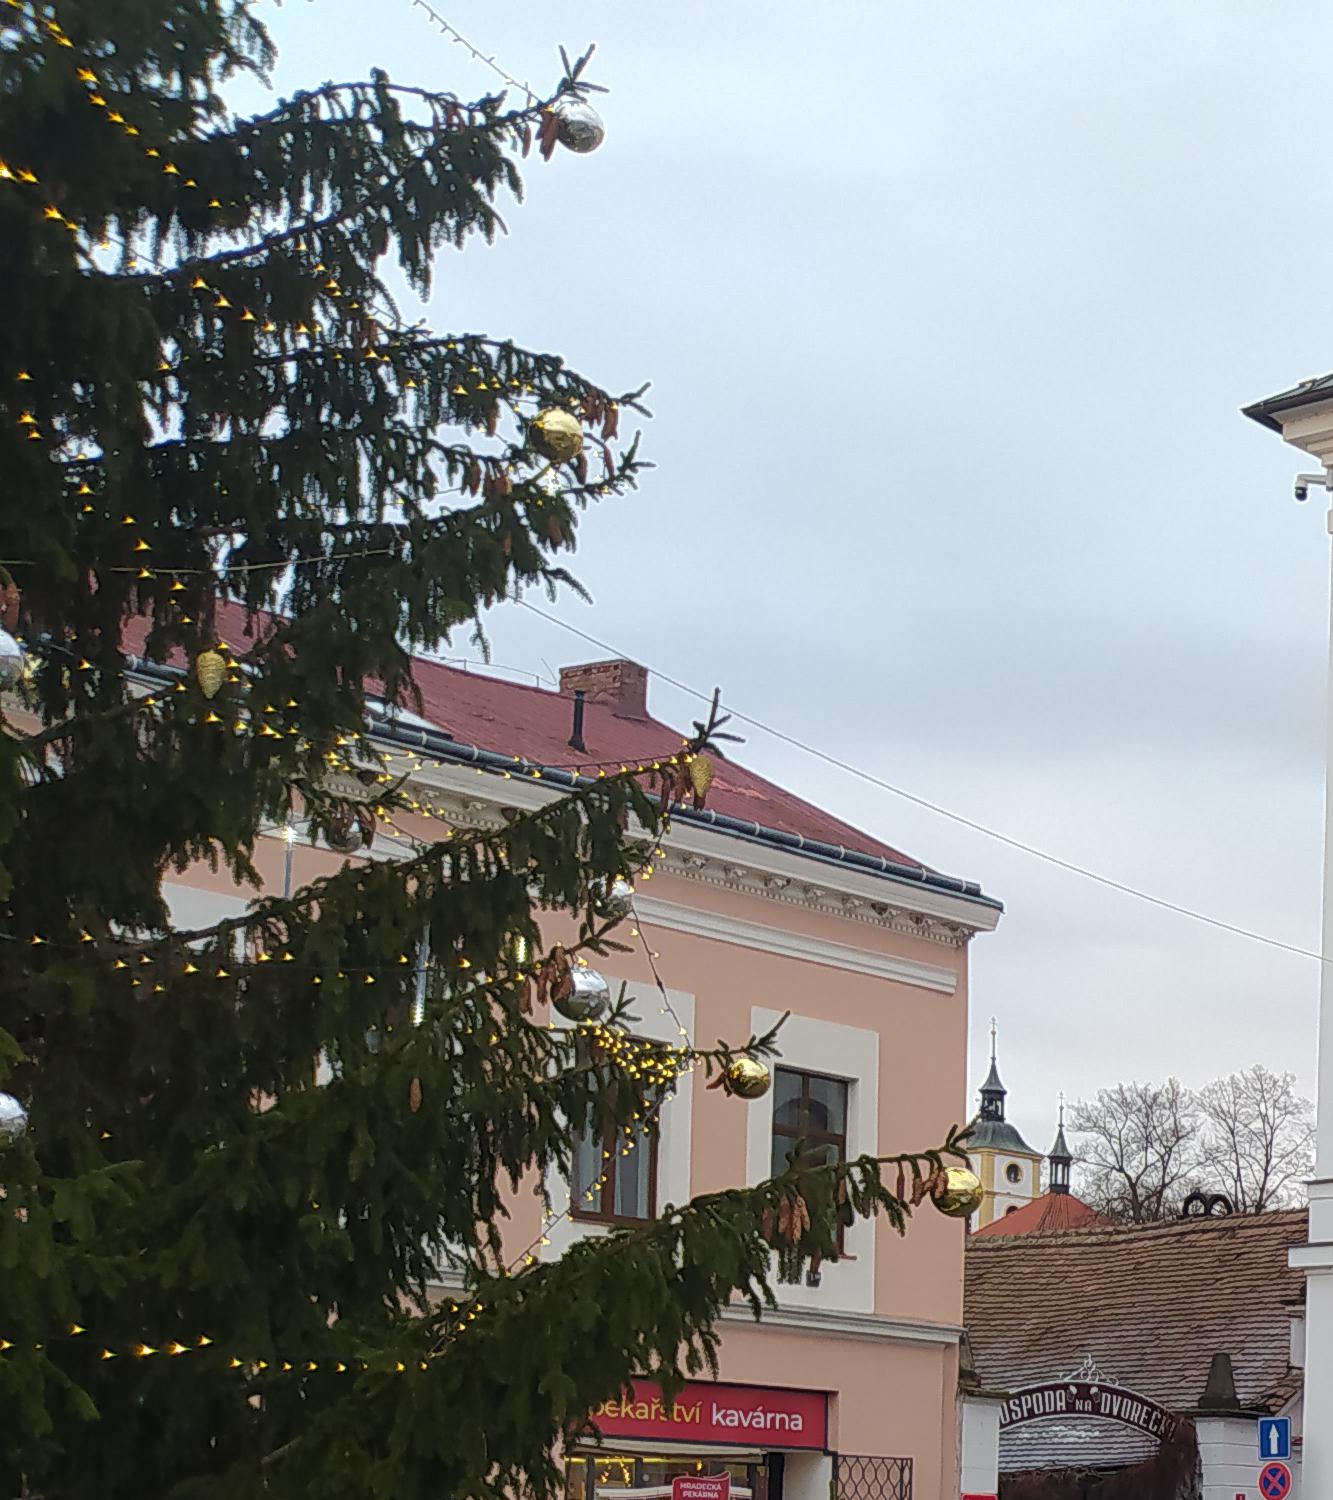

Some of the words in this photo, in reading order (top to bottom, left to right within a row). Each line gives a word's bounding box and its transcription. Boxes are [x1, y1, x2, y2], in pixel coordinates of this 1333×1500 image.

[711, 1402, 804, 1431] kavárna
[999, 1389, 1067, 1426] OSPODA
[1075, 1398, 1093, 1412] NA
